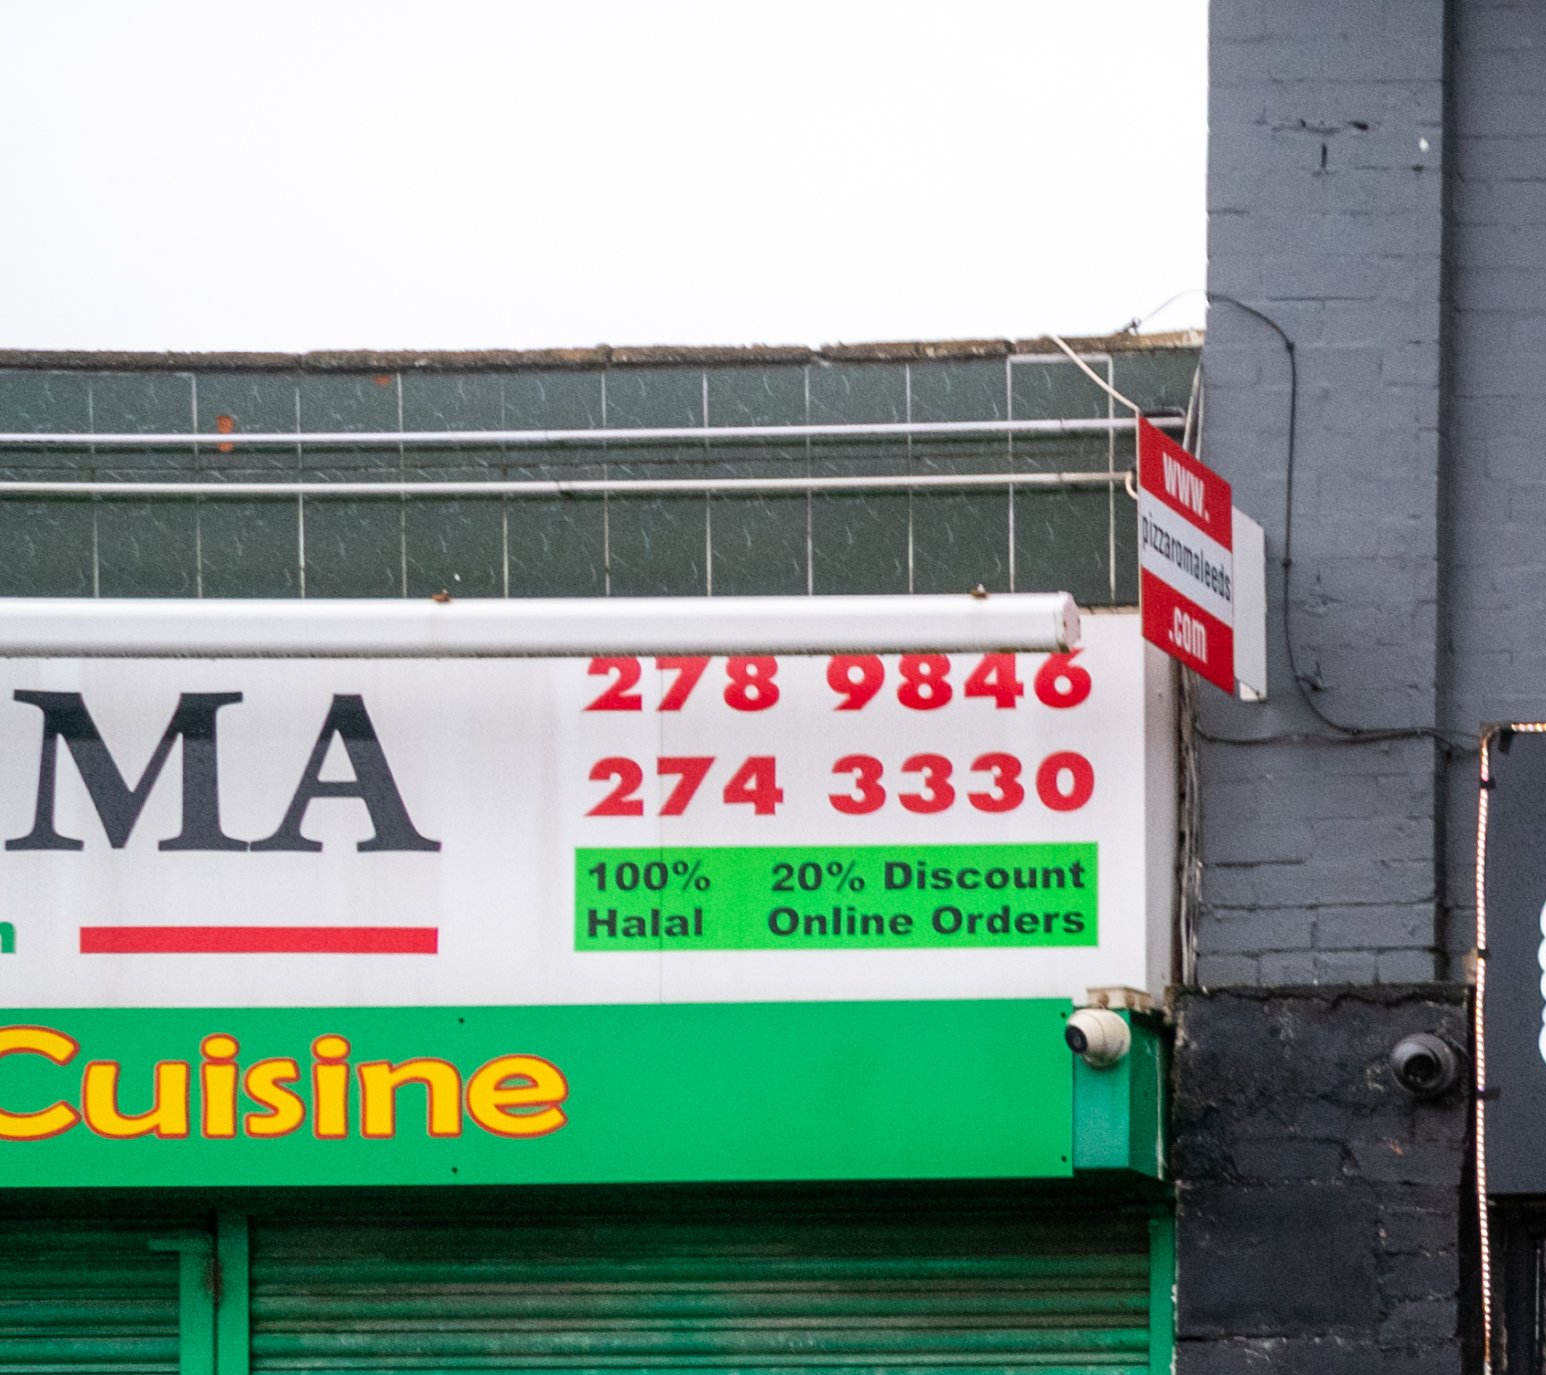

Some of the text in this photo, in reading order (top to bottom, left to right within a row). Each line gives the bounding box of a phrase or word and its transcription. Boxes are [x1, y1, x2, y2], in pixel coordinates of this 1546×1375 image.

[1163, 451, 1209, 523] www.
[1142, 512, 1231, 602] pizzaromaleeds
[1168, 606, 1208, 665] .com
[582, 646, 1092, 712] 278 9846
[584, 751, 1095, 817] 274 3330
[588, 861, 711, 893] 100%
[772, 859, 1086, 893] 20% Discount
[587, 907, 703, 938] Halal
[768, 904, 1086, 937] Online Orders
[0, 1023, 570, 1141] Cuisine
